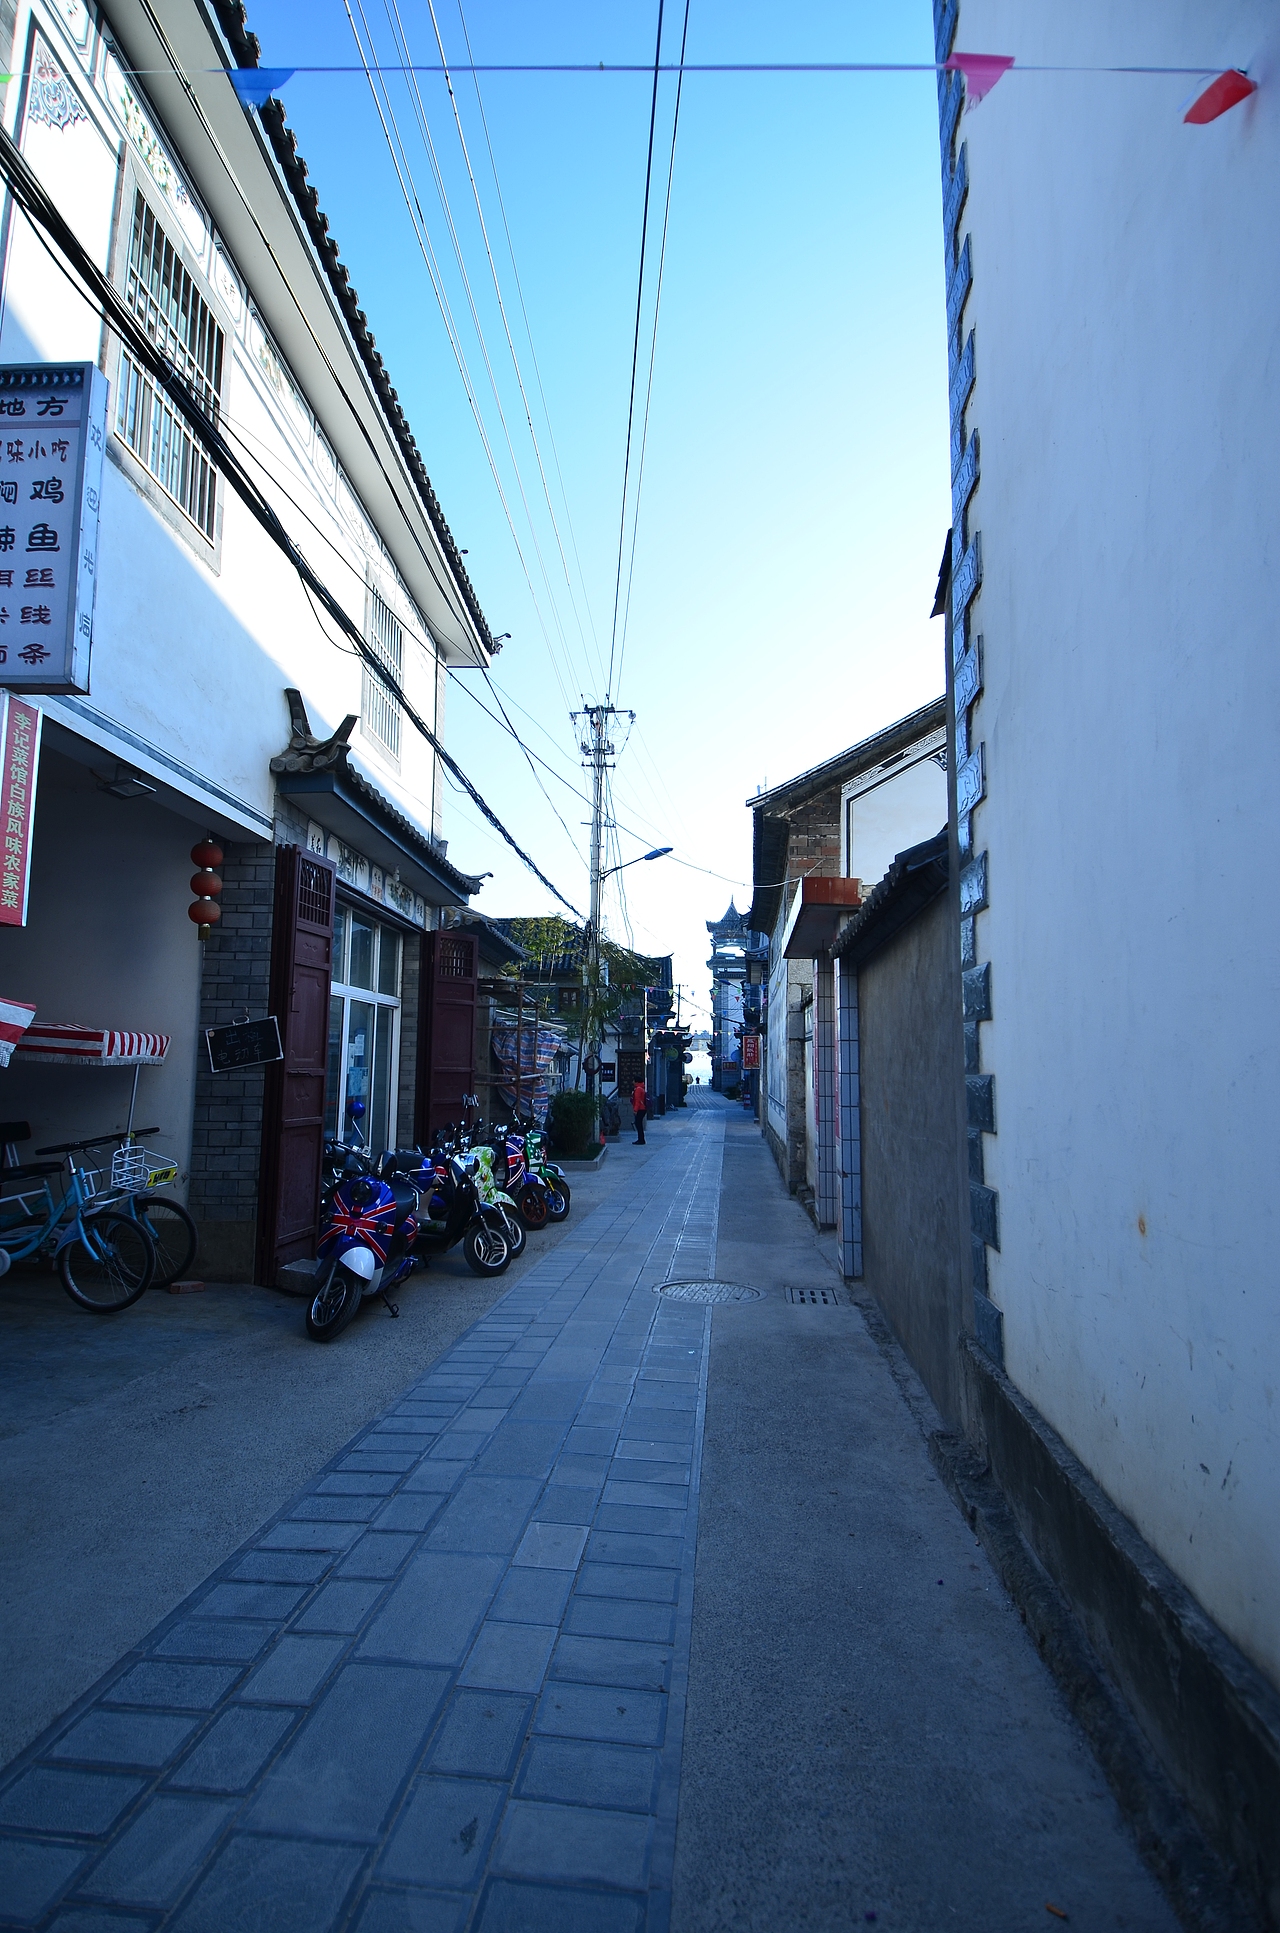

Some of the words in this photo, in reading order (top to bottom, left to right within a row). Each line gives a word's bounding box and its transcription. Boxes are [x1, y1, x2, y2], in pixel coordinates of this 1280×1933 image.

[0, 396, 69, 417] 地方
[0, 438, 70, 464] 味小吃
[79, 423, 102, 639] 欢迎光临
[0, 643, 51, 666] 条
[1, 711, 32, 910] 李记菜馆白族风味农家菜
[216, 1041, 264, 1065] 电动车
